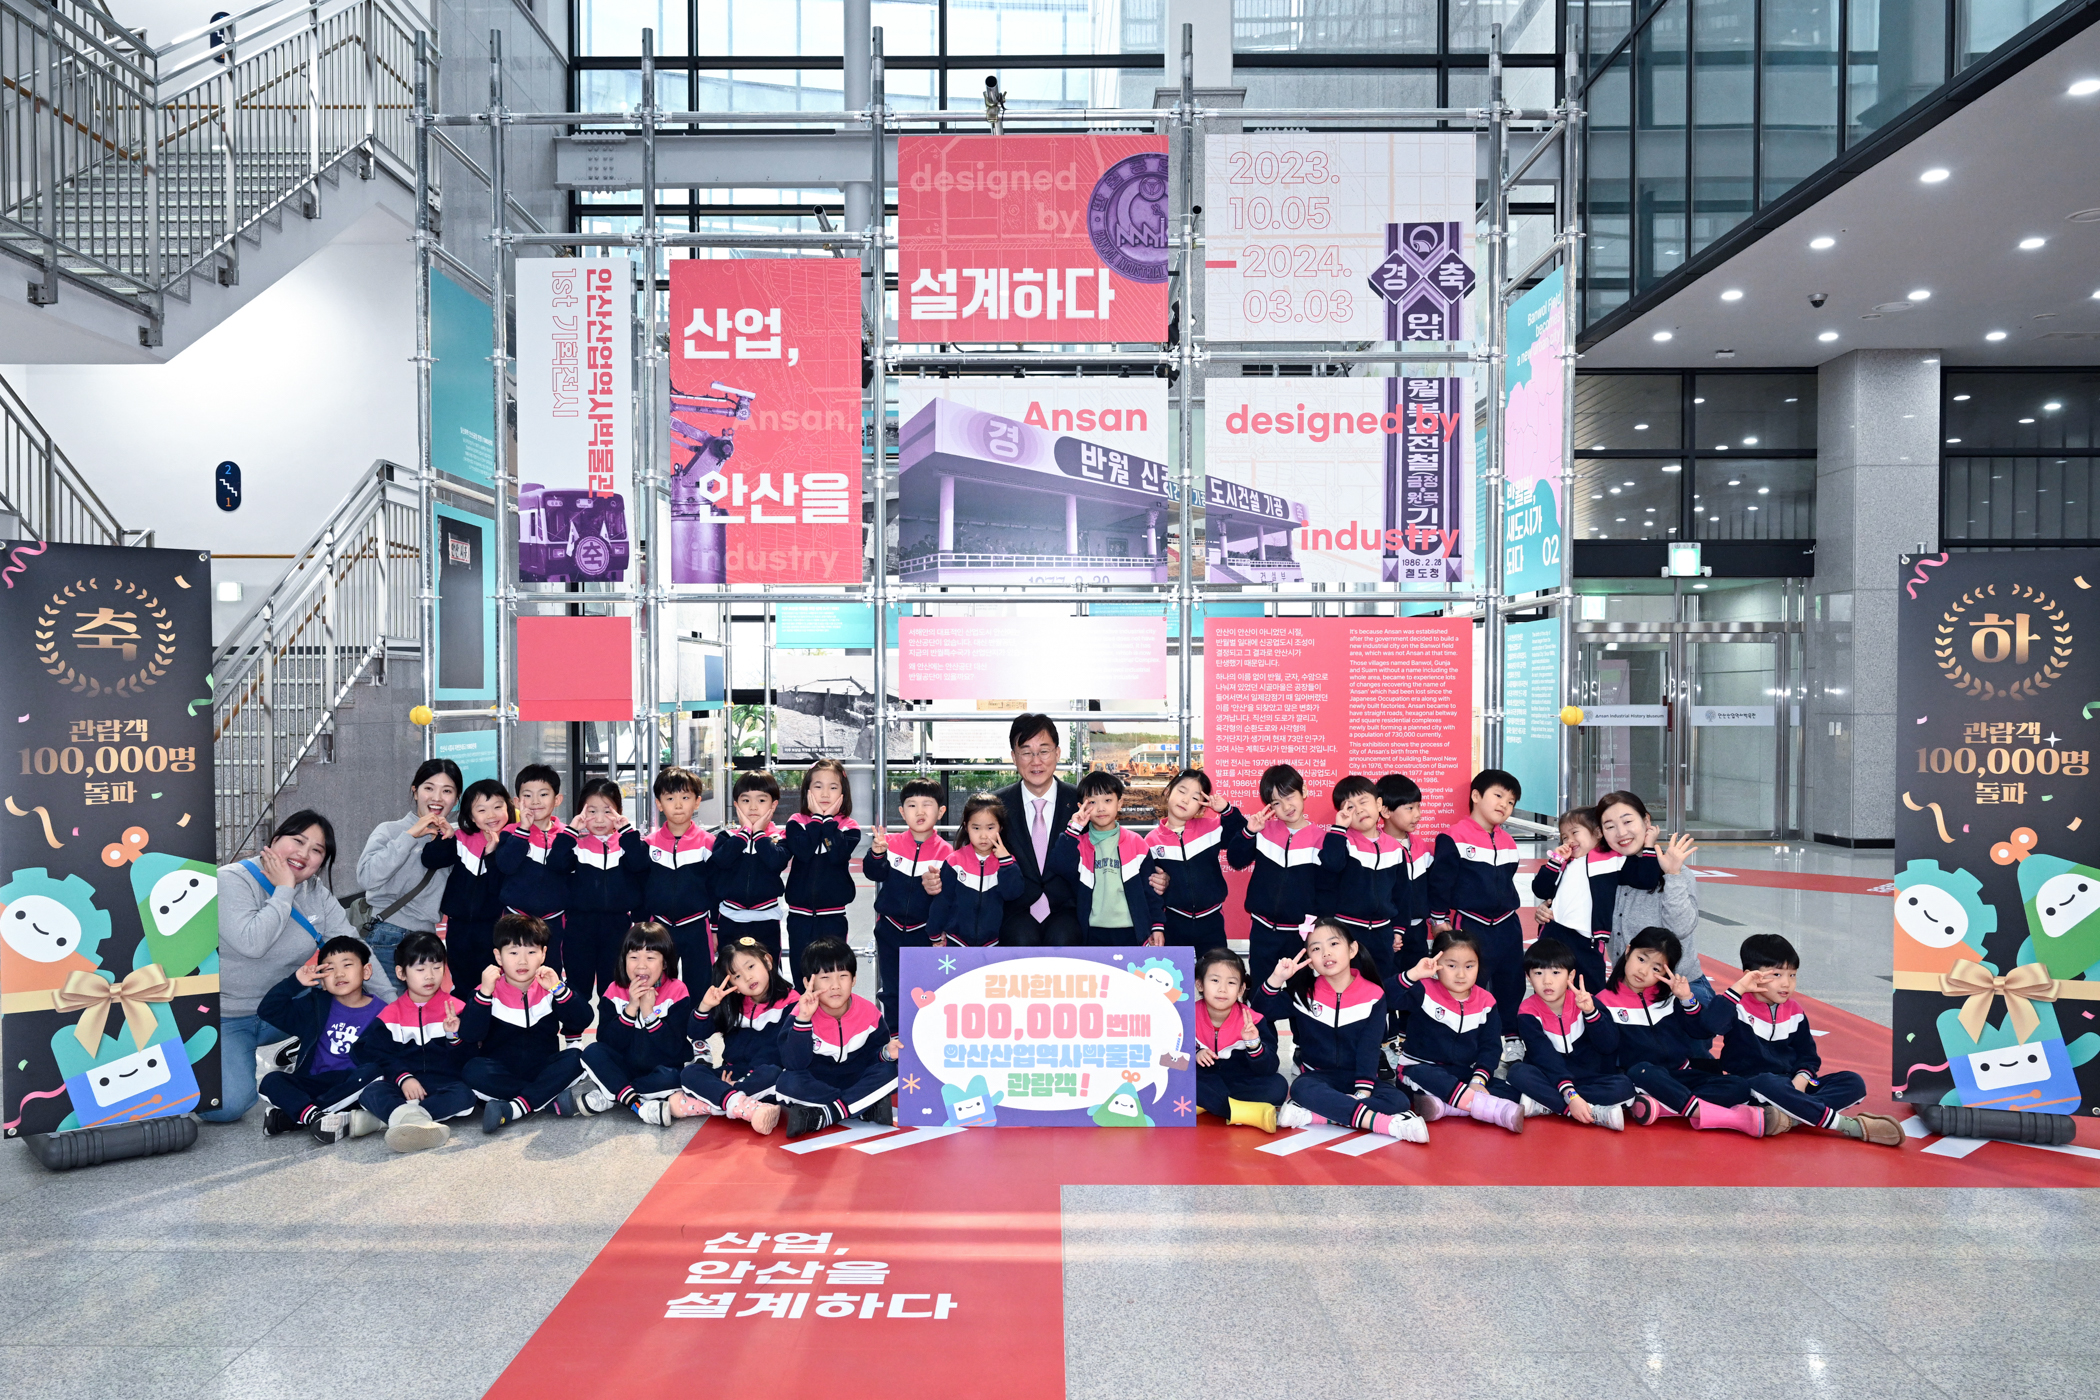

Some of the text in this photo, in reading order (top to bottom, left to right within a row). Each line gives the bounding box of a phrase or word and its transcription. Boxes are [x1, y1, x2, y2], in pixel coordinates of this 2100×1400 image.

[910, 162, 1076, 199] designed
[1229, 151, 1340, 185] 2023.
[1037, 203, 1080, 238] by
[1229, 196, 1331, 230] 10.05
[1093, 230, 1166, 278] PANWOL INDUSTRIAL
[1242, 245, 1352, 277] 2024.
[1382, 262, 1465, 290] 경 축
[910, 268, 1115, 320] 설계하다
[1243, 289, 1353, 323] 03.03
[1527, 290, 1561, 327] Banwol Field
[684, 307, 799, 367] 산업,
[1535, 312, 1561, 337] becomes
[552, 269, 578, 418] 1st 기획전시
[586, 268, 614, 498] 안산산업역사박물관
[731, 407, 853, 434] Ansan,
[1023, 401, 1148, 431] Ansan
[1226, 403, 1460, 442] designed by
[989, 420, 1019, 458] 경
[225, 465, 231, 474] 2
[1080, 442, 1130, 486] 반월
[226, 497, 231, 507] 1
[699, 472, 849, 524] 안산을
[1210, 477, 1260, 512] 도시건설
[1264, 494, 1284, 518] 기공
[1506, 474, 1536, 511] 반월벌,
[1301, 520, 1459, 558] industry
[1506, 505, 1543, 543] 새도시가
[692, 545, 838, 578] industry
[1506, 545, 1524, 575] 되다
[1542, 534, 1559, 566] 02
[1405, 568, 1439, 579] 철도청
[72, 607, 142, 662] 축
[1968, 613, 2041, 665] 하
[69, 720, 149, 743] 관람객
[1216, 724, 1242, 732] 육각형의
[1963, 721, 2041, 745] 관람객
[18, 746, 197, 778] 100,000명
[1231, 745, 1244, 753] 사는
[1281, 745, 1307, 753] 만들어진
[1310, 745, 1337, 753] 것입니다.
[1915, 747, 2090, 778] 100,000명
[84, 781, 138, 806] 돌파
[1975, 782, 2028, 805] 돌파
[985, 974, 1110, 999] 감사합니다!
[943, 1044, 1152, 1068] 안산산업역사박물관
[1007, 1073, 1090, 1097] 관람객!
[703, 1232, 850, 1256] 산업,
[684, 1260, 890, 1285] 안산을
[663, 1292, 958, 1319] 설계하다
